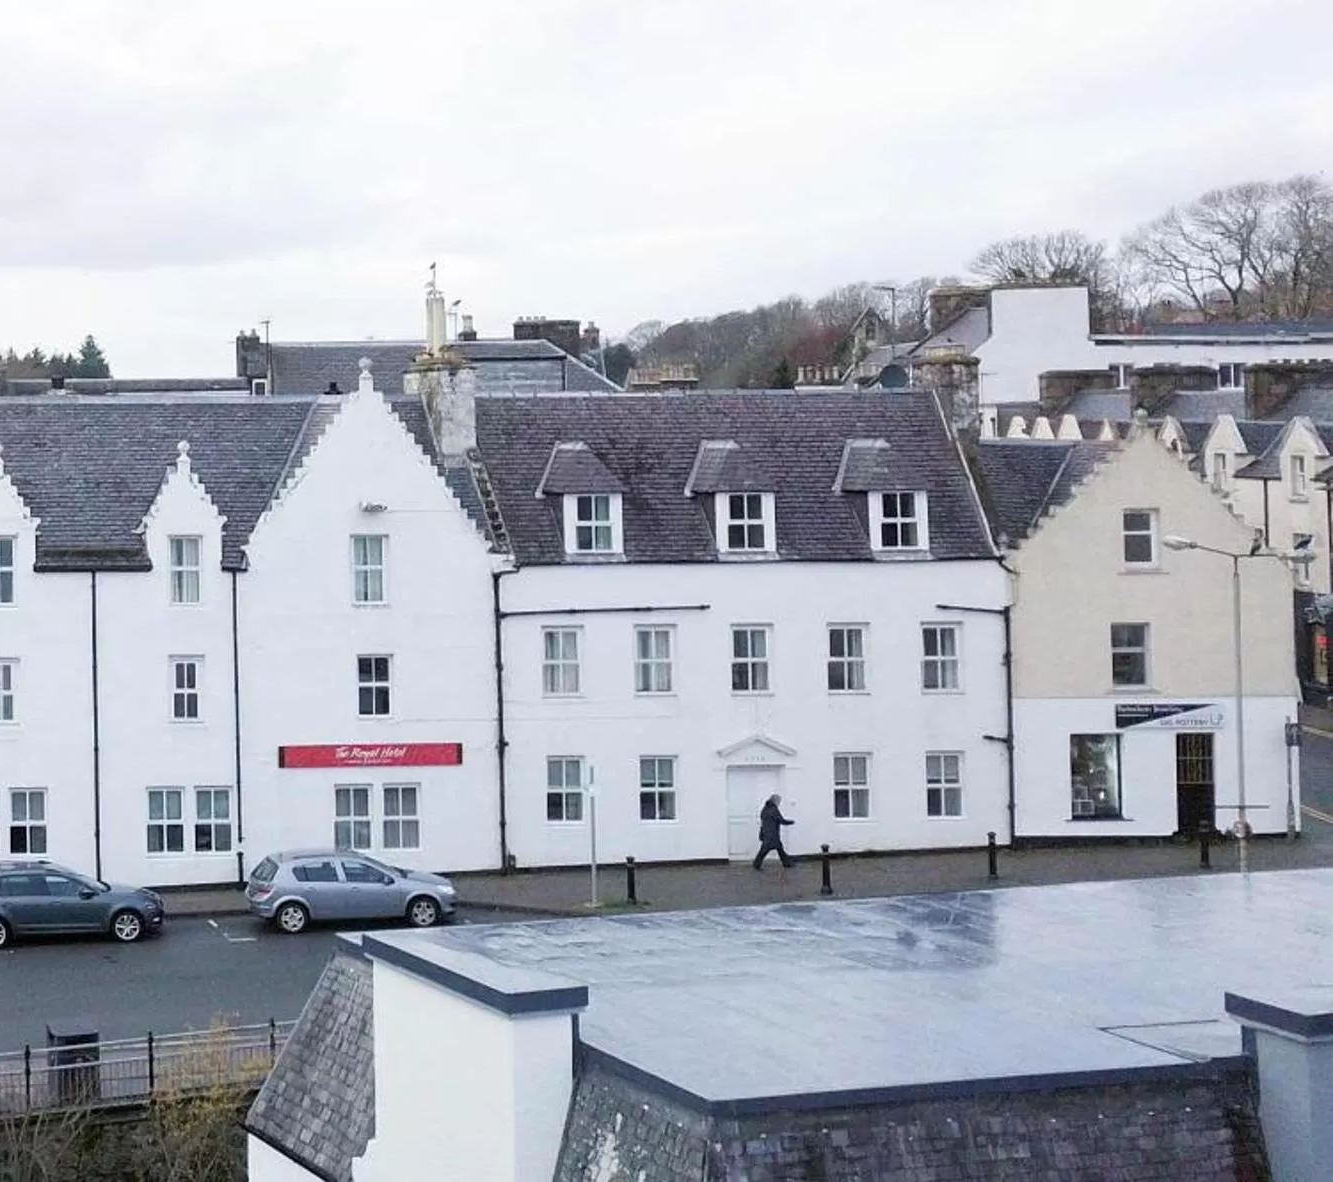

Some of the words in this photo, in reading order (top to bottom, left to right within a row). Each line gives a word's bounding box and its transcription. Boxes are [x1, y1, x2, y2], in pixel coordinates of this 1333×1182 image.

[335, 746, 349, 758] The
[351, 746, 380, 760] Royal
[380, 746, 407, 758] Hotel
